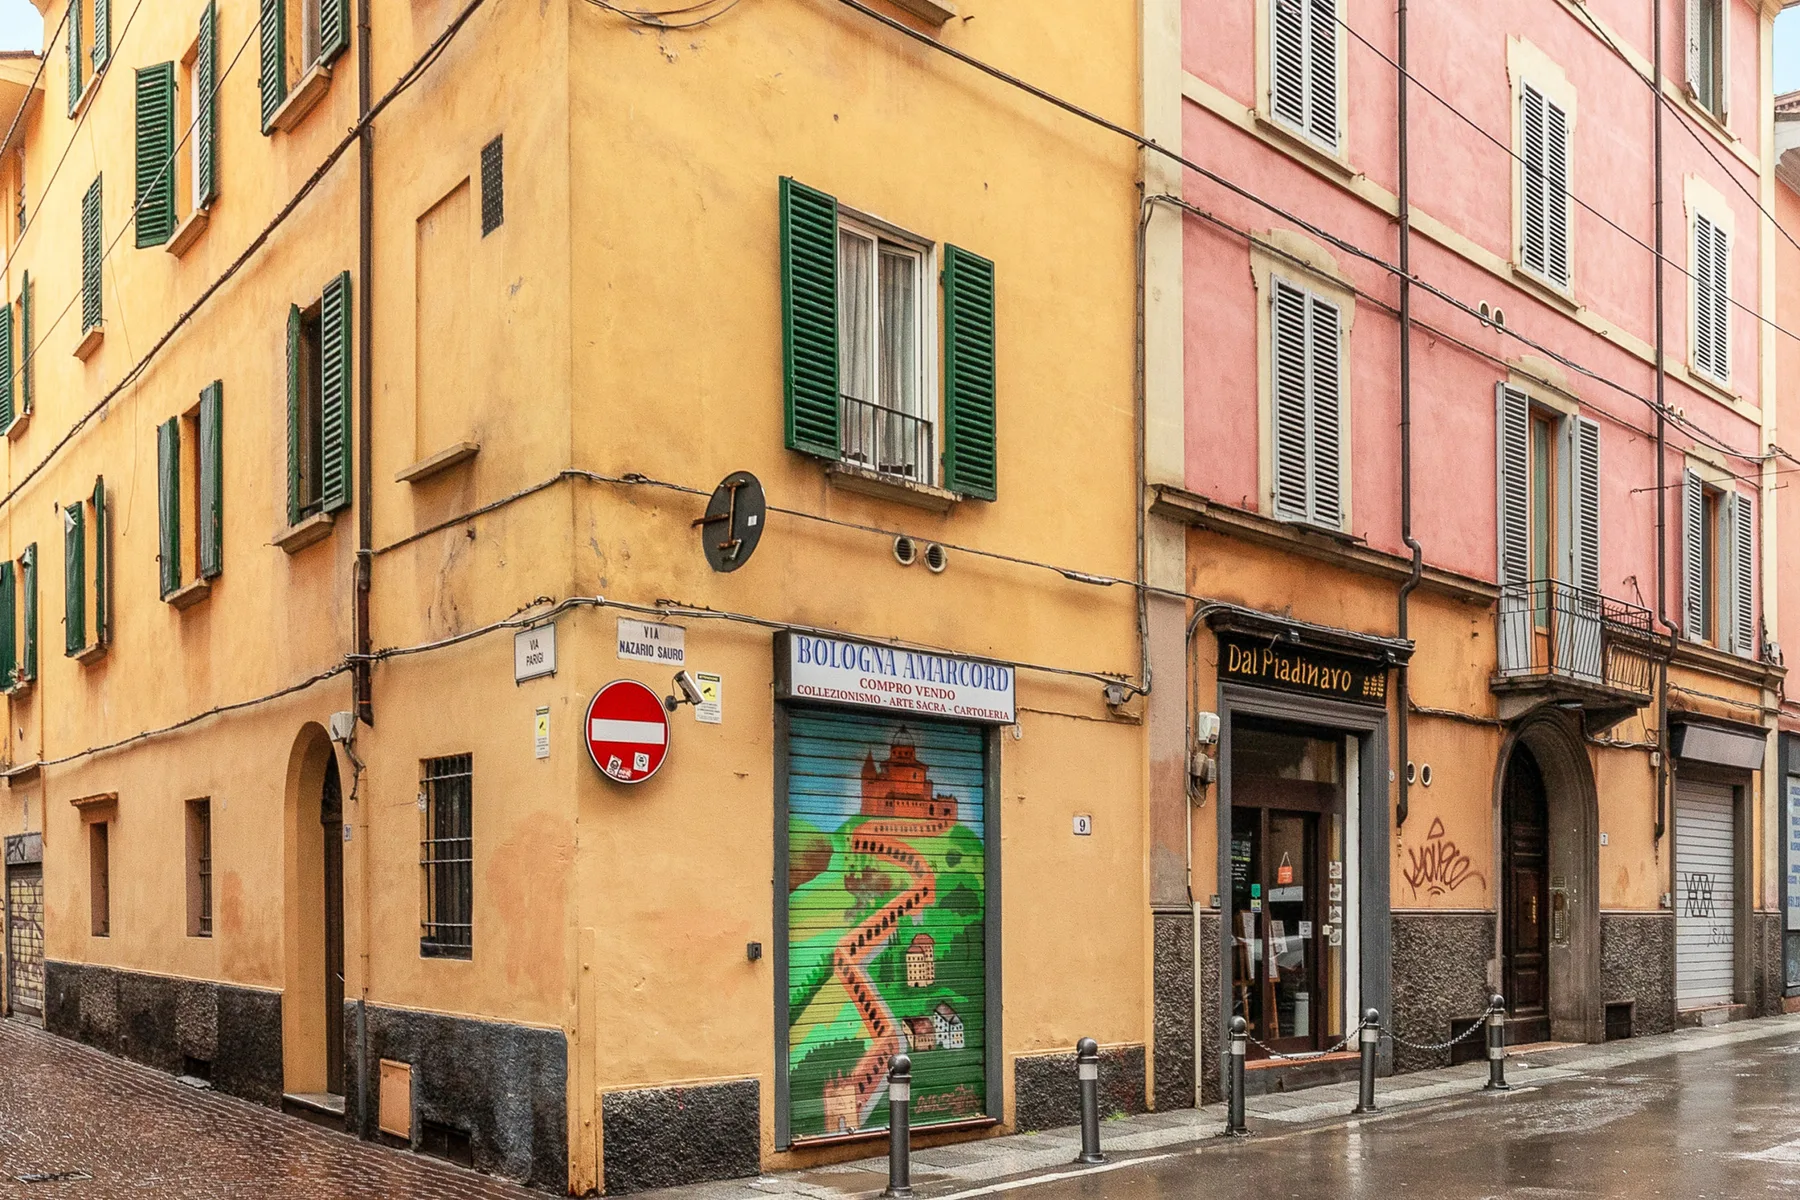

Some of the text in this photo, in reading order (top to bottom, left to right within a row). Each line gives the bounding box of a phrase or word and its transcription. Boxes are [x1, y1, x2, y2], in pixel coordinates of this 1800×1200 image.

[644, 625, 660, 640] VIA
[529, 638, 540, 651] VIA
[619, 639, 684, 661] NAZARIO SAURO
[525, 651, 544, 667] PARIGI
[796, 635, 1009, 692] BOLOGNA AMARCORD
[1228, 643, 1258, 676] Dal
[859, 677, 956, 701] COMPRO VENDO
[796, 684, 881, 704] COLLEZIONISMO
[889, 696, 914, 709] ARTE
[916, 700, 947, 713] SACRA
[953, 704, 1010, 720] CARTOLERIA
[1079, 818, 1086, 833] 9
